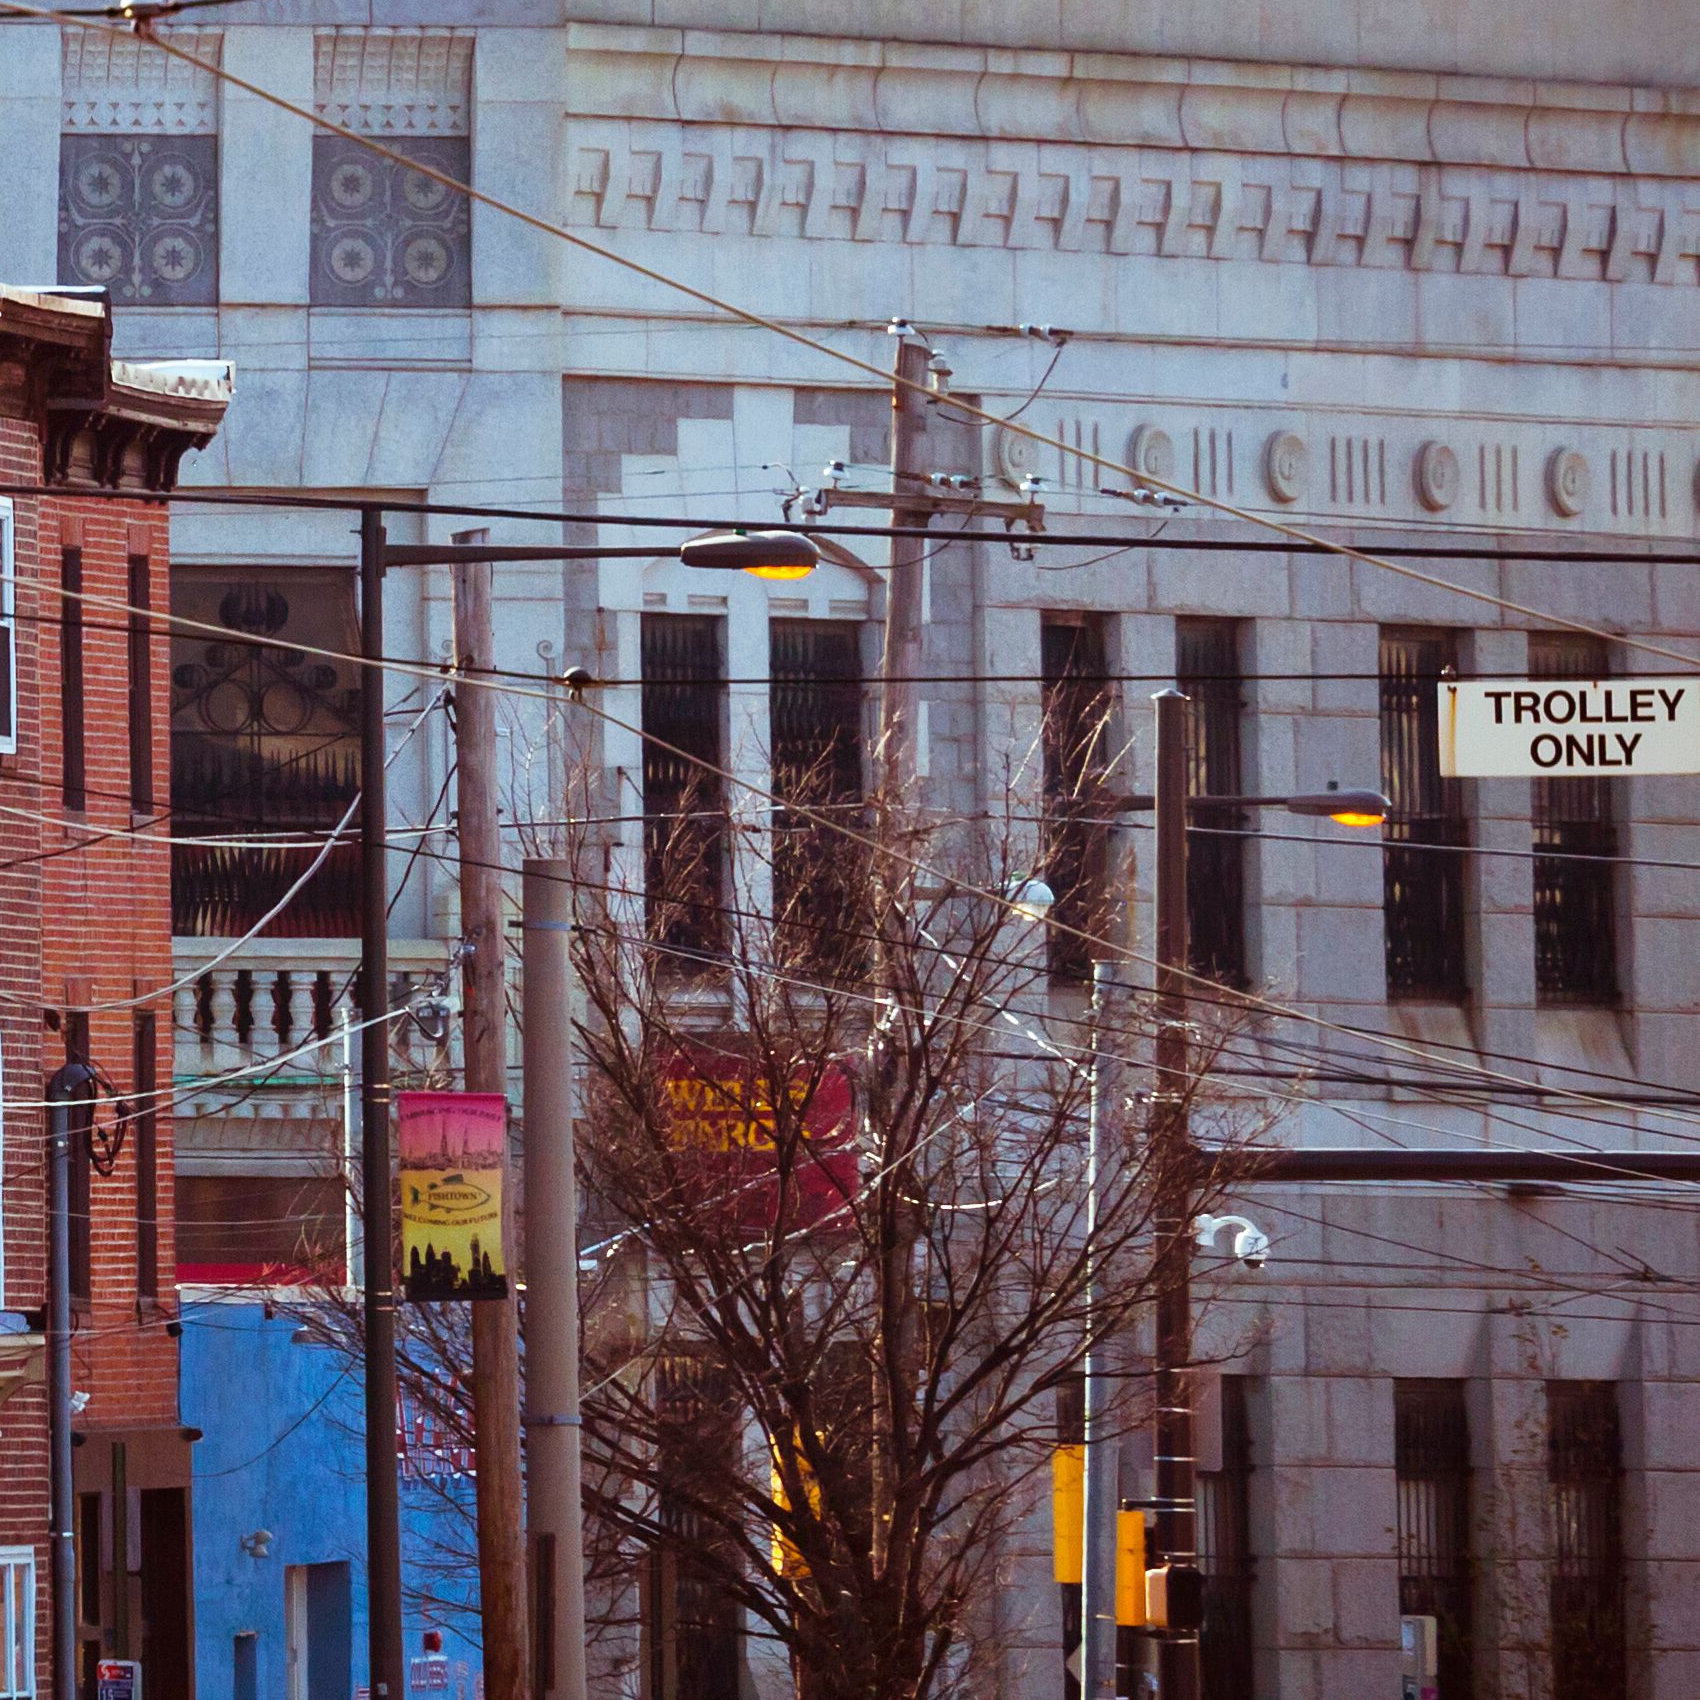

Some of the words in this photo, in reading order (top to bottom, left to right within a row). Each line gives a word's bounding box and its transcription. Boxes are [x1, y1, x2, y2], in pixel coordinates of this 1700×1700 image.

[1484, 689, 1686, 724] TROLLEY
[1530, 733, 1642, 768] ONLY
[428, 1191, 478, 1201] FISHTOWN
